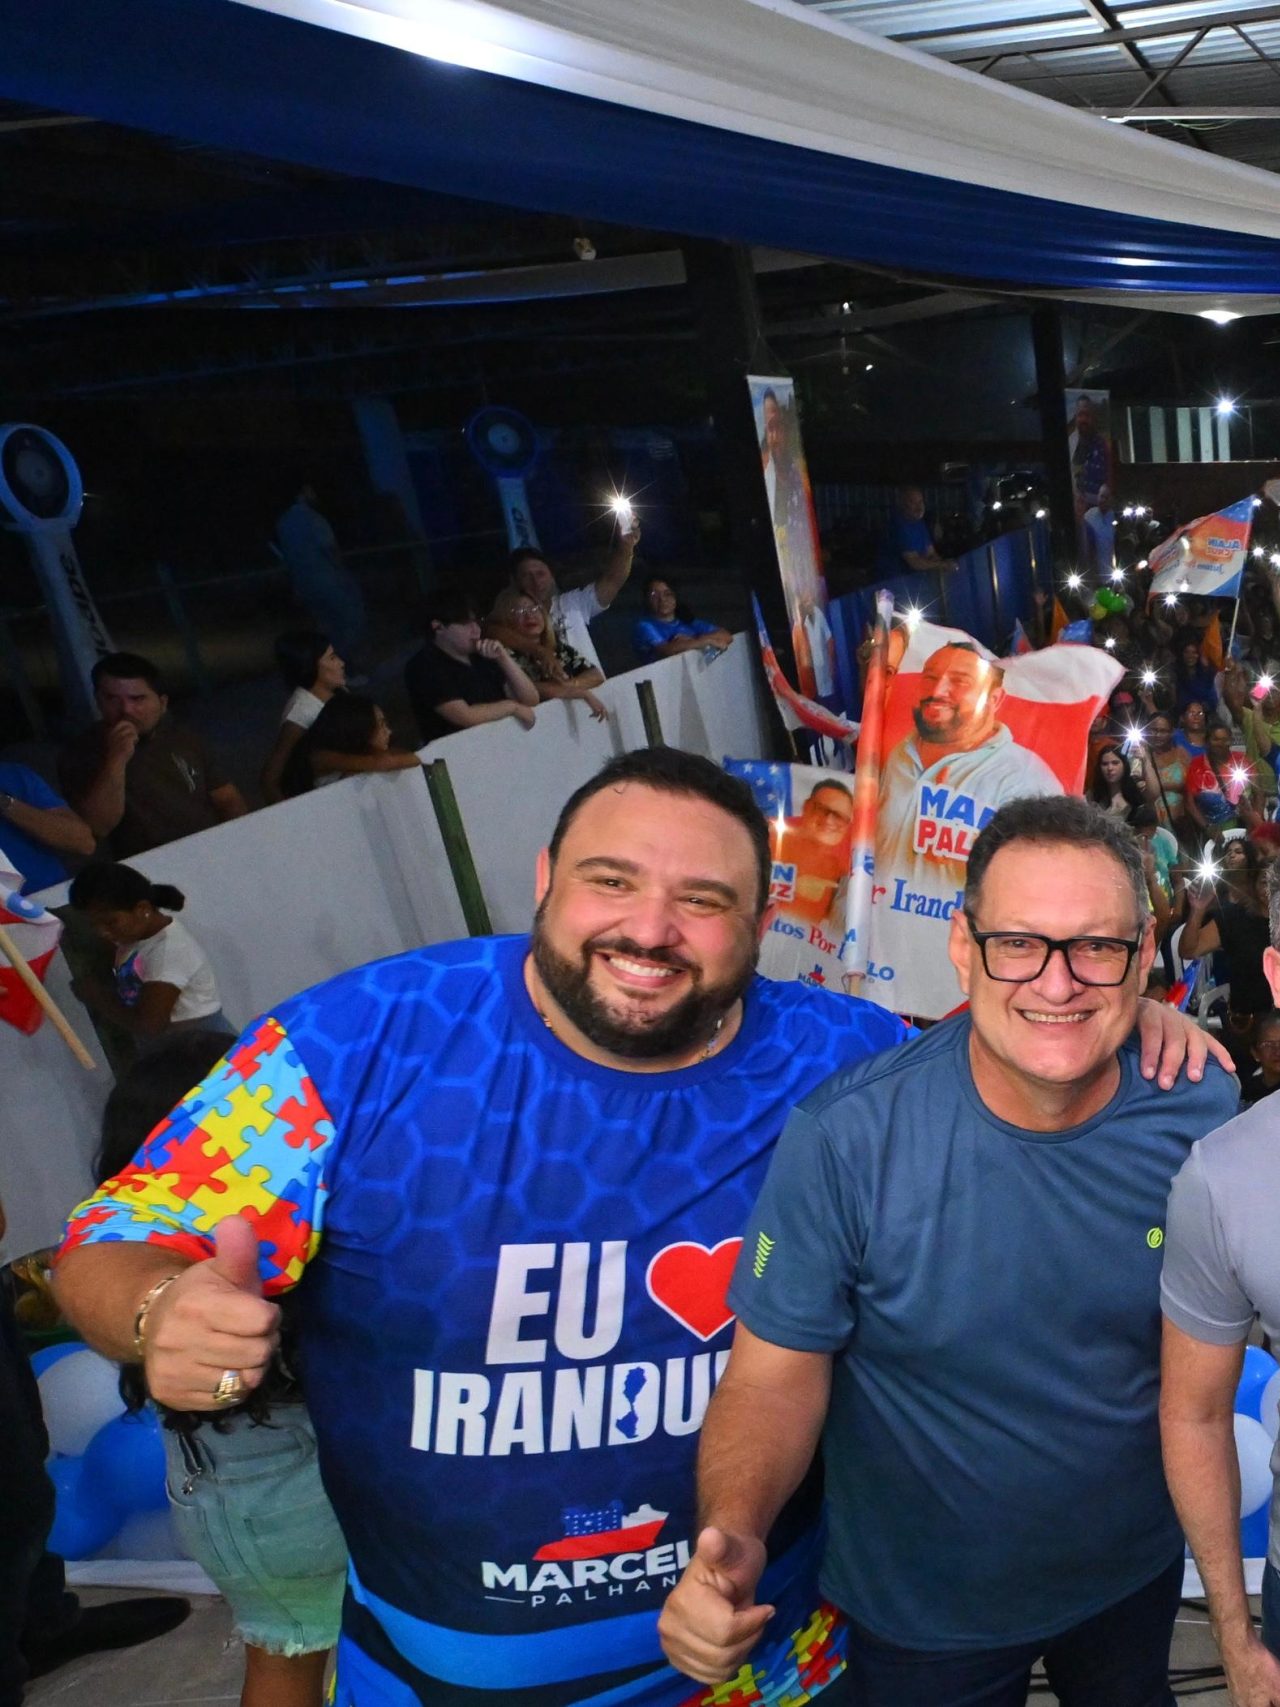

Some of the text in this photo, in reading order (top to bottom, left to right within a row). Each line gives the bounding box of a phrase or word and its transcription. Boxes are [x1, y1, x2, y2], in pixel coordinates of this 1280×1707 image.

[890, 878, 964, 921] Irand
[485, 1240, 628, 1365] EU
[410, 1349, 732, 1456] IRANDU
[481, 1540, 692, 1592] MARCEL
[531, 1574, 677, 1608] PALHAN
